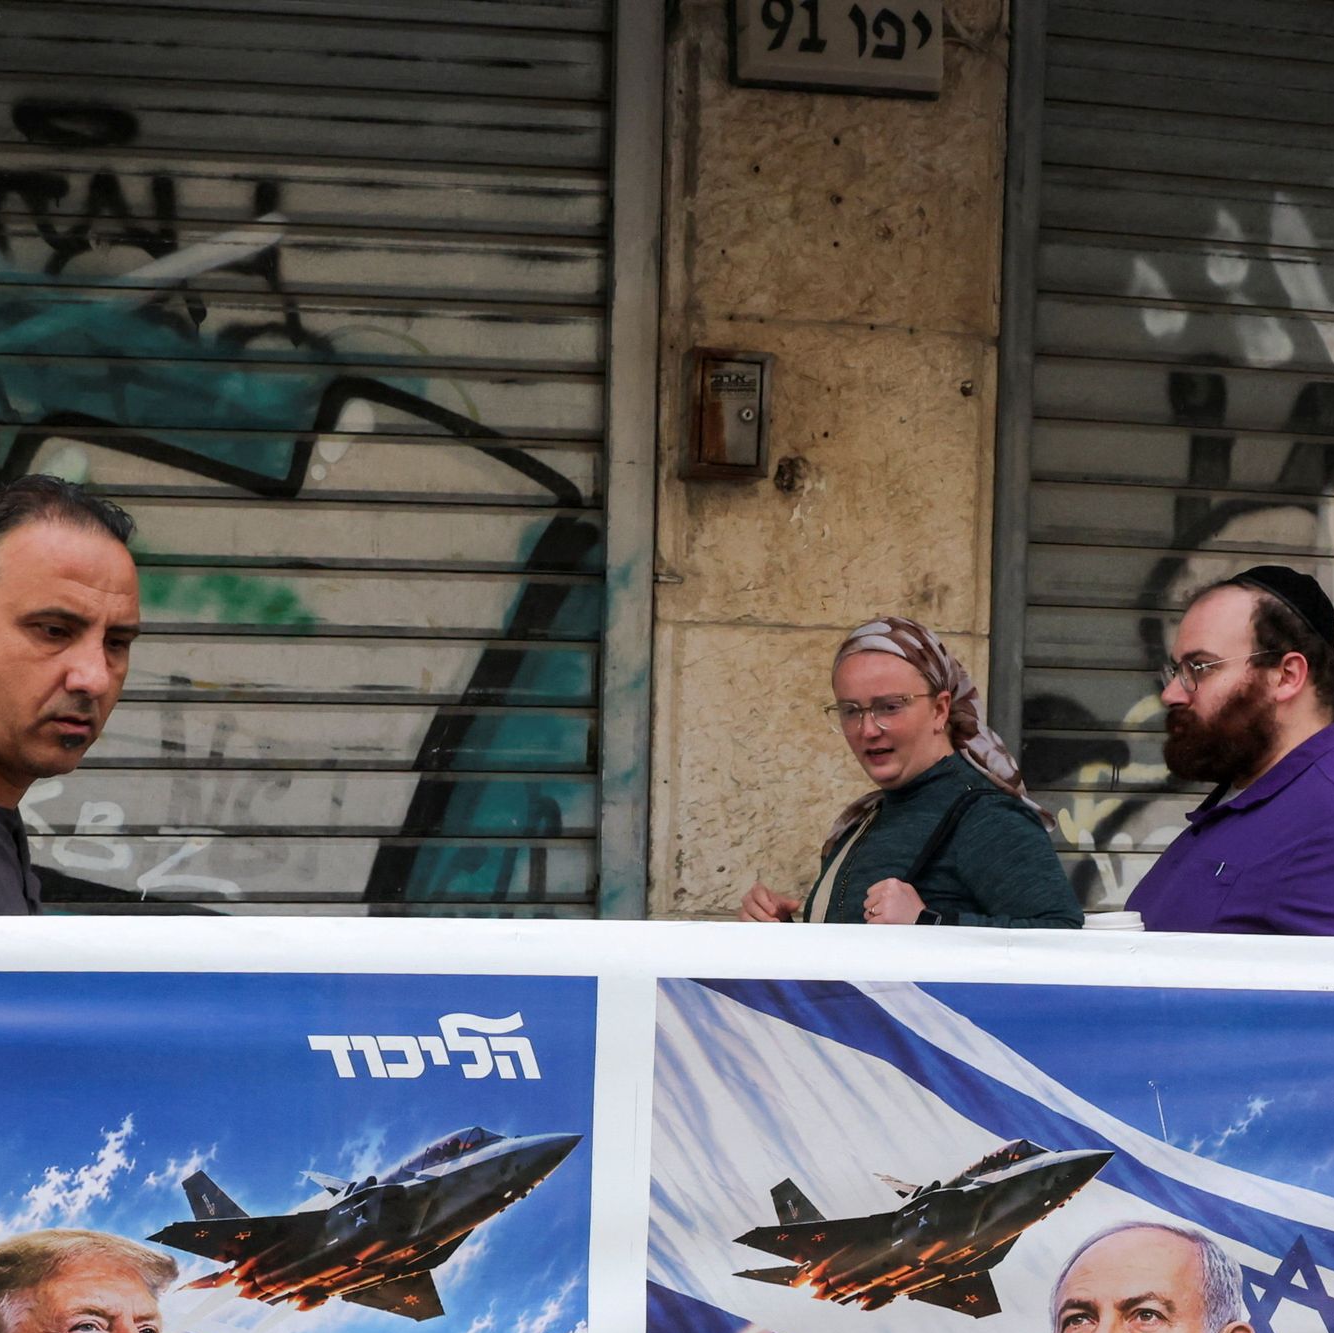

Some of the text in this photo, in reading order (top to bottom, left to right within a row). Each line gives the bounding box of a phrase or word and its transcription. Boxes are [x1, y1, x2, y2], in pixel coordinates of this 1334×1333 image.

[761, 0, 933, 60] יפו 91
[307, 1011, 542, 1080] הליכוד
